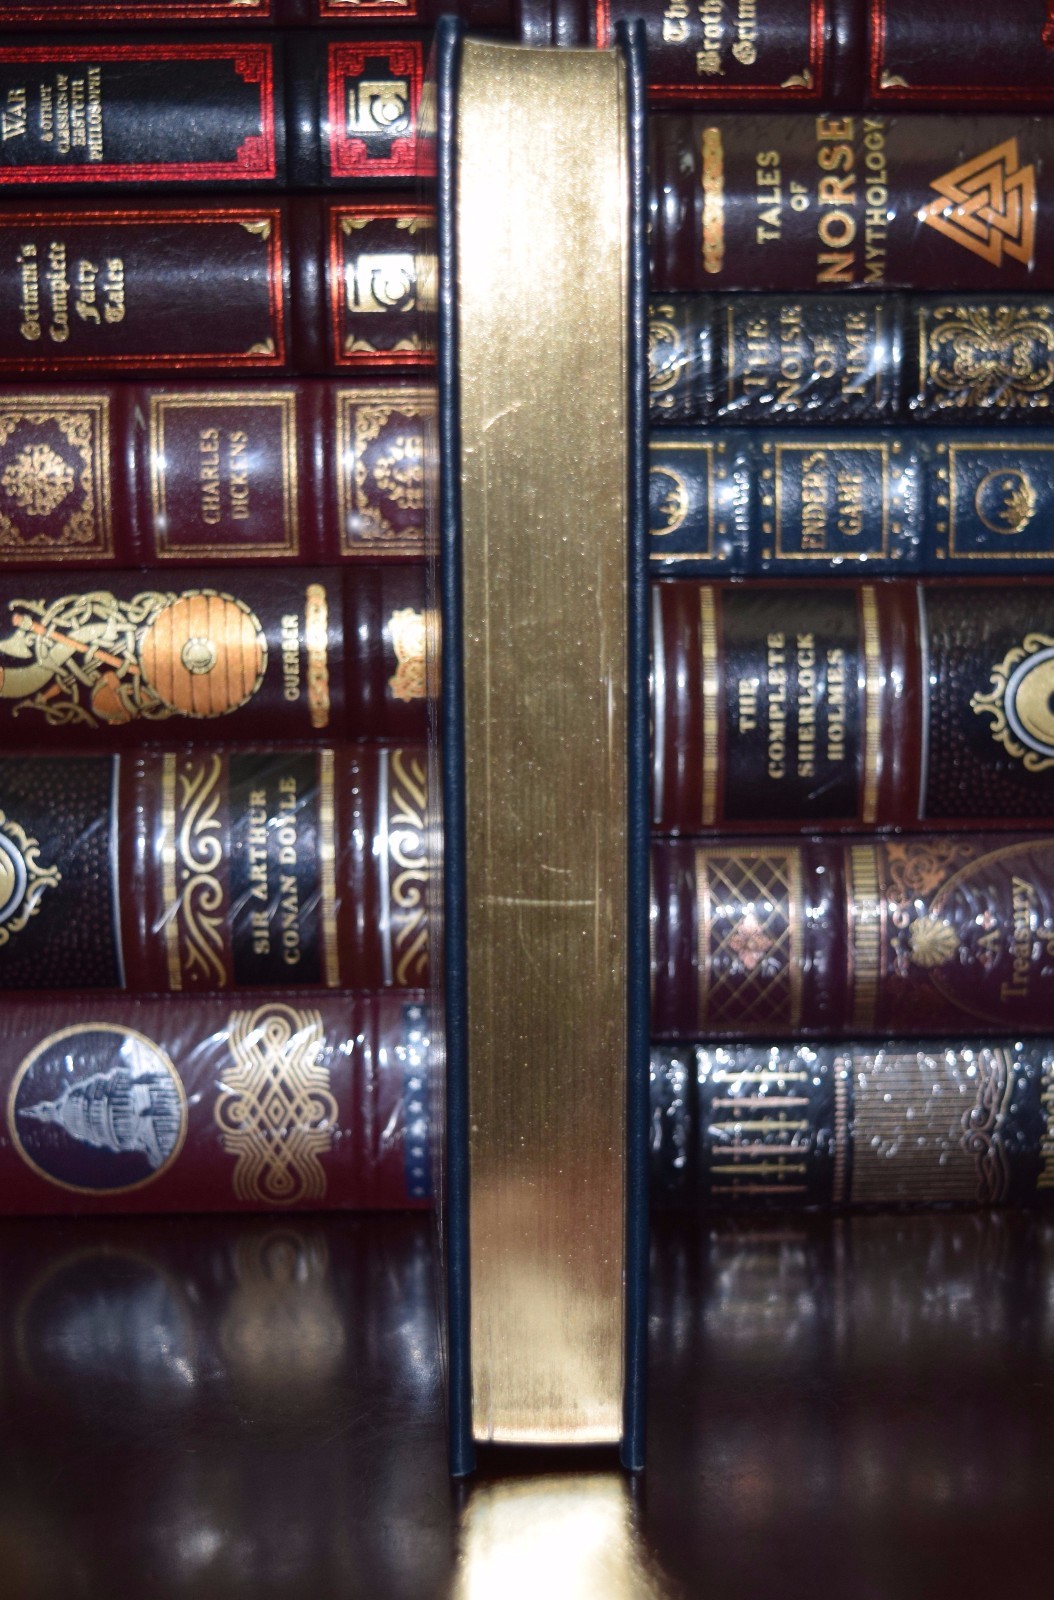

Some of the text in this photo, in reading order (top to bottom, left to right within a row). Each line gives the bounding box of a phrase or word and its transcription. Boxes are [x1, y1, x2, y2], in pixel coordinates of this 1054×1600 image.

[1, 87, 27, 141] WAR
[755, 150, 782, 245] TALES
[789, 180, 810, 212] OF
[815, 117, 857, 284] NORSE
[863, 117, 888, 284] MYTHOLOGY
[16, 244, 41, 341] Grimm's
[45, 241, 70, 343] Complete
[75, 259, 101, 325] Fairy
[102, 257, 126, 324] Tales
[743, 318, 768, 394] THE
[775, 305, 803, 407] NOISE
[813, 336, 836, 379] OF
[841, 311, 867, 403] TIME
[199, 427, 221, 525] CHARLES
[228, 430, 250, 520] DICKENS
[281, 614, 300, 701] GUERBER
[796, 632, 817, 778] SHERLOCK
[826, 648, 846, 761] HOLMES
[738, 678, 757, 734] THE
[767, 632, 788, 780] COMPLETE
[248, 788, 270, 955] SIR ARTHUR
[278, 776, 300, 965] CONAN DOYLE
[977, 929, 1001, 953] A
[1000, 875, 1034, 1002] Treasury
